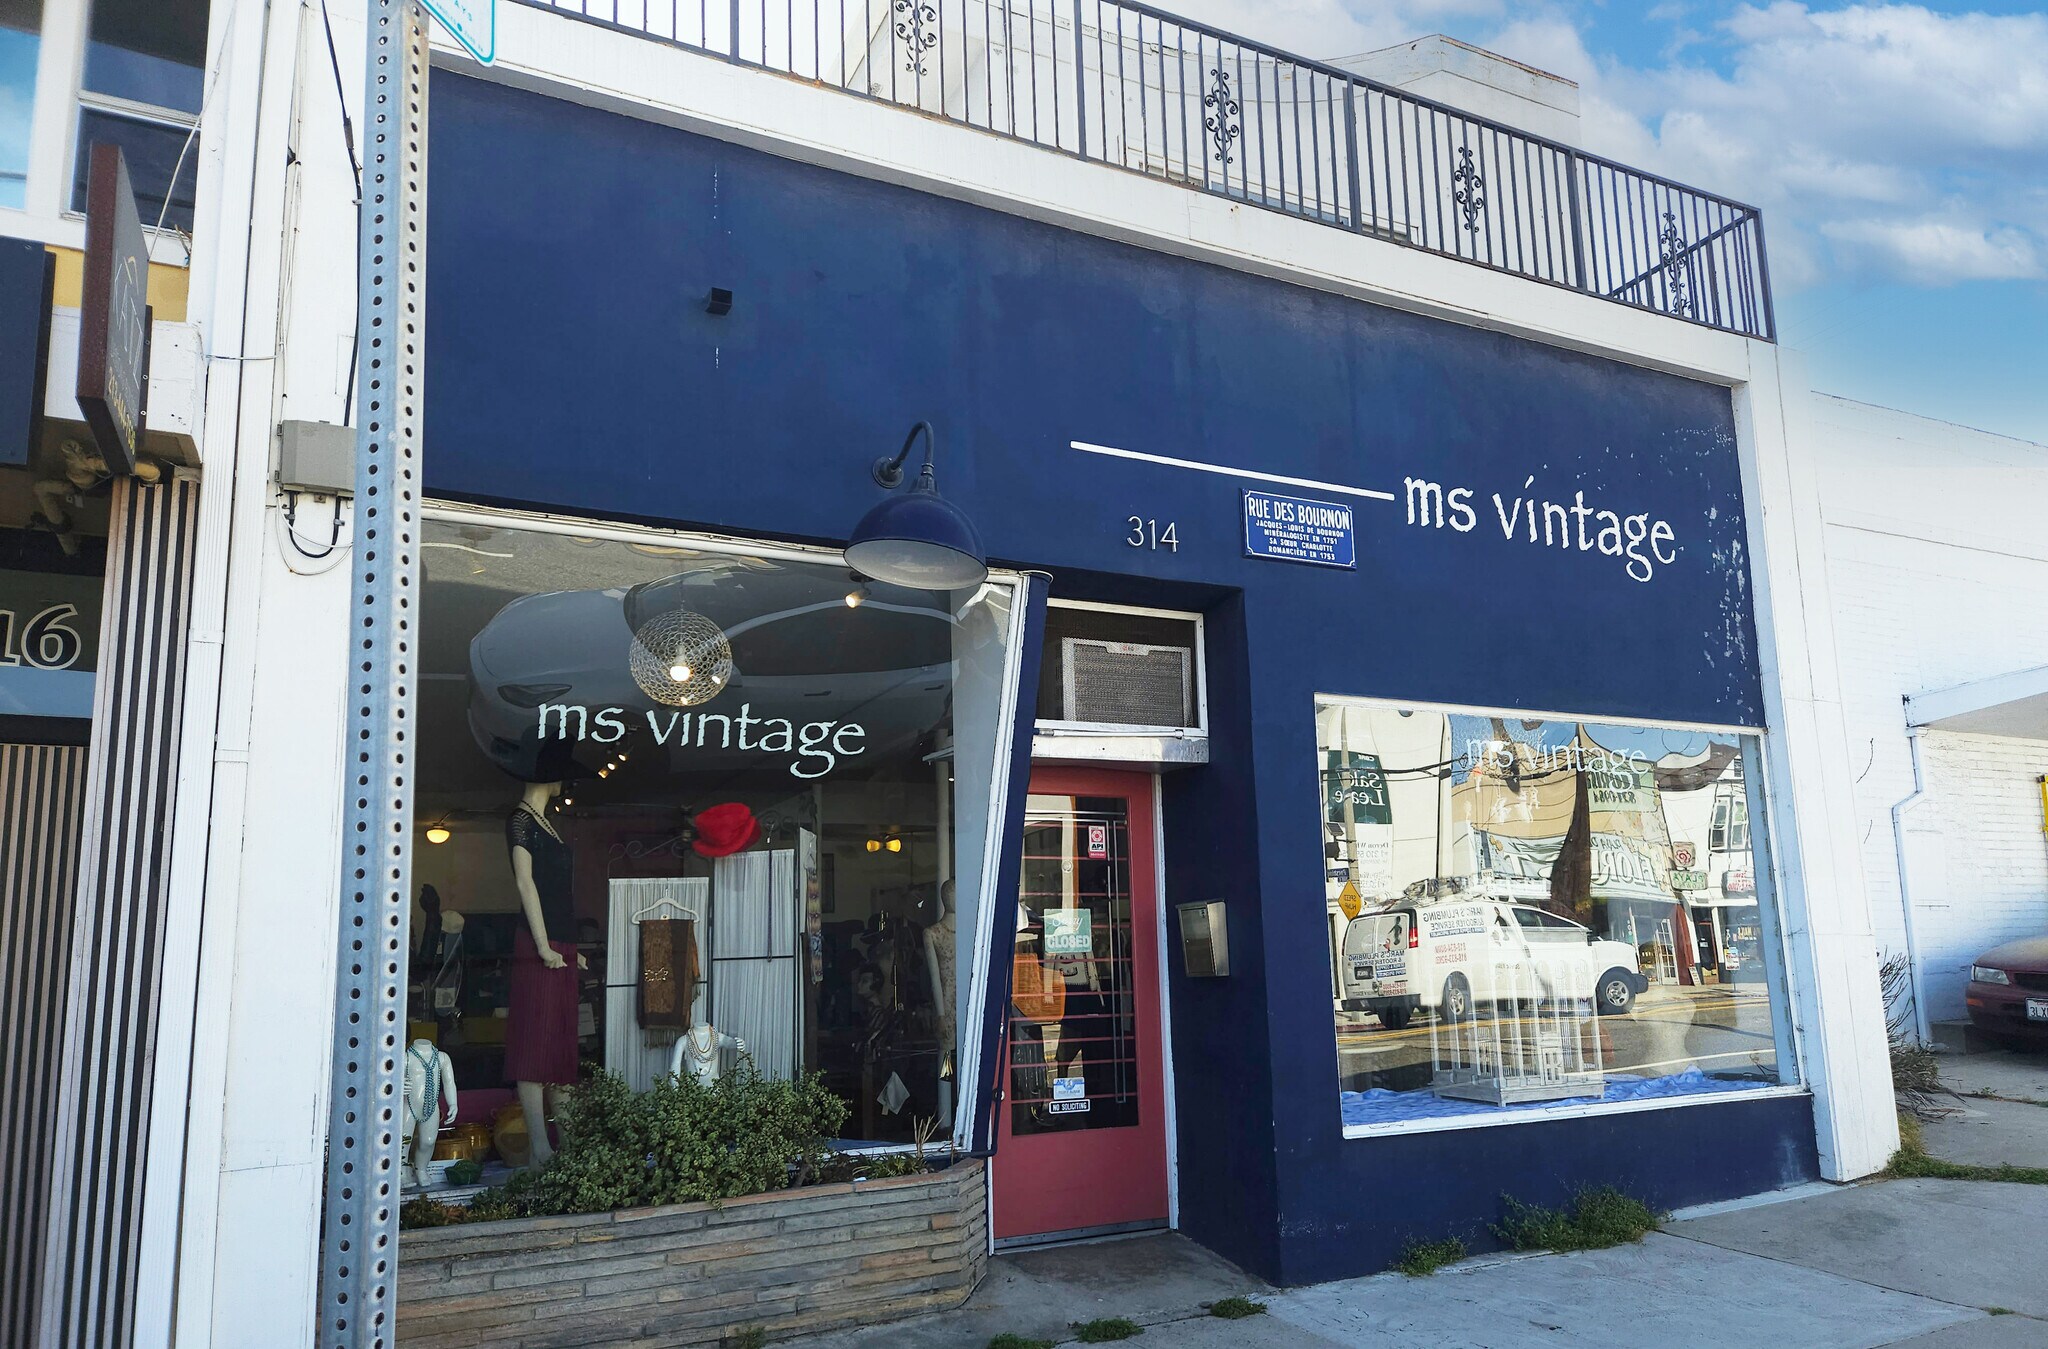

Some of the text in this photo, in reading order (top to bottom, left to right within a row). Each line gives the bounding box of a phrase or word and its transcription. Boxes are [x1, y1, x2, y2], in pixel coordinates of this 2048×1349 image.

[1248, 497, 1350, 530] RUE DES BOURNON
[1403, 476, 1477, 532] ms
[1127, 516, 1179, 552] 314
[1302, 542, 1333, 552] CHARLOTTE
[537, 703, 625, 743] ms
[1466, 737, 1514, 768] ms
[1047, 934, 1090, 949] CLOSED
[2030, 1006, 2048, 1018] 3LX
[1053, 1102, 1087, 1112] NO SOLICITING
